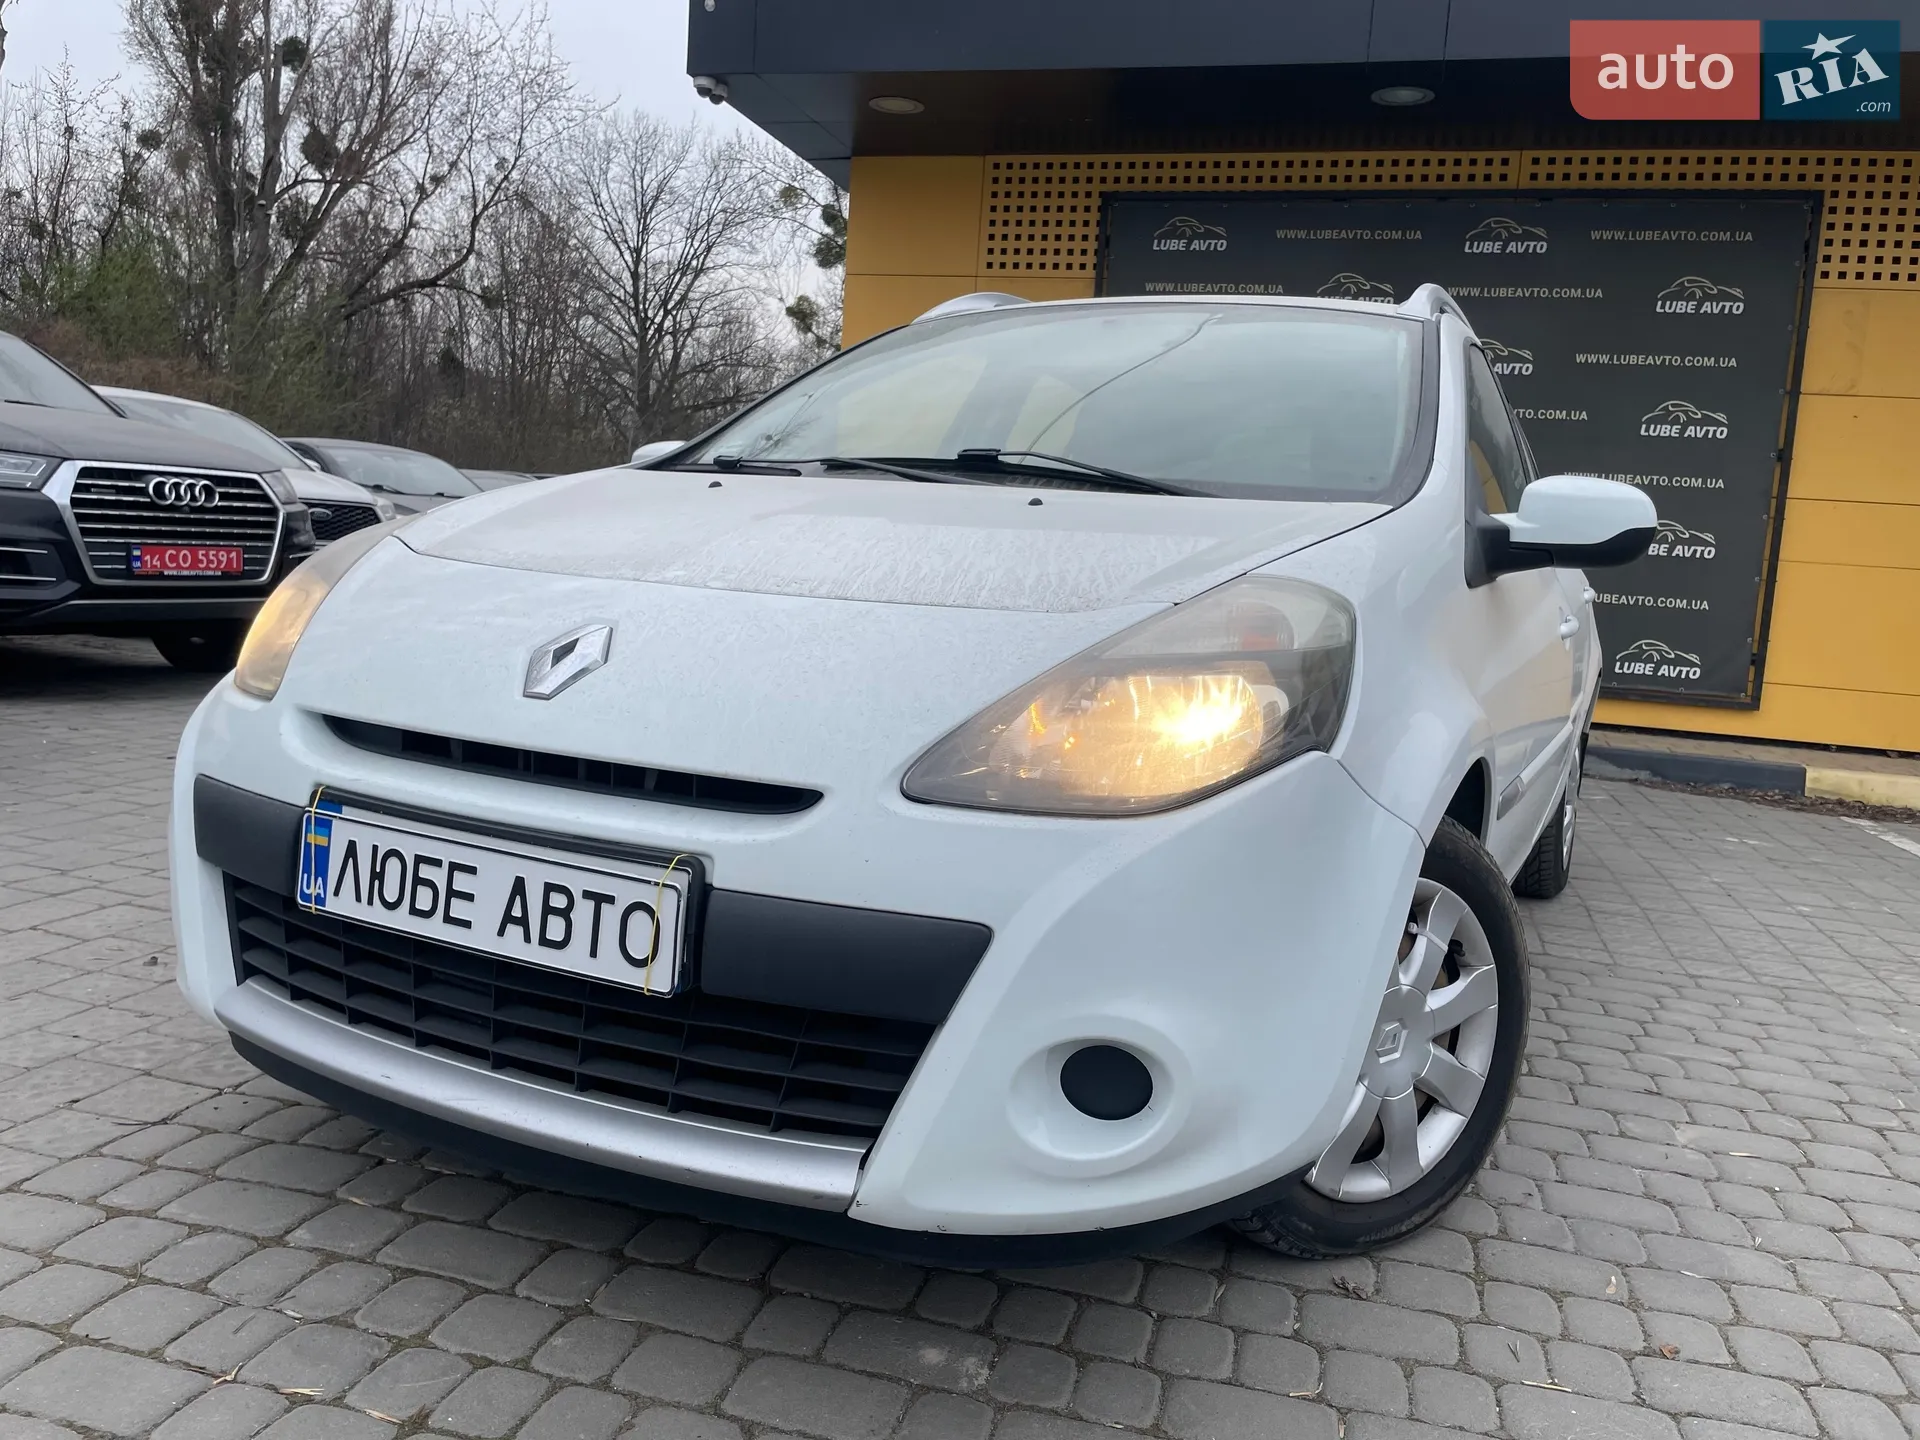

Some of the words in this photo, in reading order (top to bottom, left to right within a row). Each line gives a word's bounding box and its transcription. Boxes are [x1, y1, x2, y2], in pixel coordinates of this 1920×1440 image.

[1276, 228, 1422, 241] WWW.LUBEAVTO.COM.UA
[1590, 229, 1753, 242] WWW.LUBEAVTO.COM.UA
[1152, 239, 1187, 251] LUBE
[1190, 239, 1228, 251] AVTO
[1464, 241, 1503, 254] LUBE
[1505, 241, 1548, 254] AVTO
[1145, 281, 1284, 294] WWW.LUBEAVTO.COM.UA
[1448, 286, 1603, 299] WWW.LUBEAVTO.COM.UA
[1656, 301, 1696, 314] LUBE
[1699, 301, 1744, 315] AVTO
[1575, 353, 1738, 368] WWW.LUBEAVTO.COM.UA
[1493, 362, 1533, 376] AVTO
[1640, 424, 1681, 438] LUBE
[1684, 425, 1728, 439] AVTO
[1648, 543, 1669, 556] BE
[1671, 545, 1716, 559] AVTO
[144, 554, 161, 569] 14
[165, 549, 192, 568] CO
[198, 550, 237, 569] 5591
[1594, 593, 1709, 611] UBEAVTO.COM.UA
[1614, 661, 1654, 676] LUBE
[1657, 665, 1701, 680] AVTO
[302, 873, 325, 899] UA
[332, 838, 478, 930] ЛЮБЕ
[496, 874, 662, 969] АВТО
